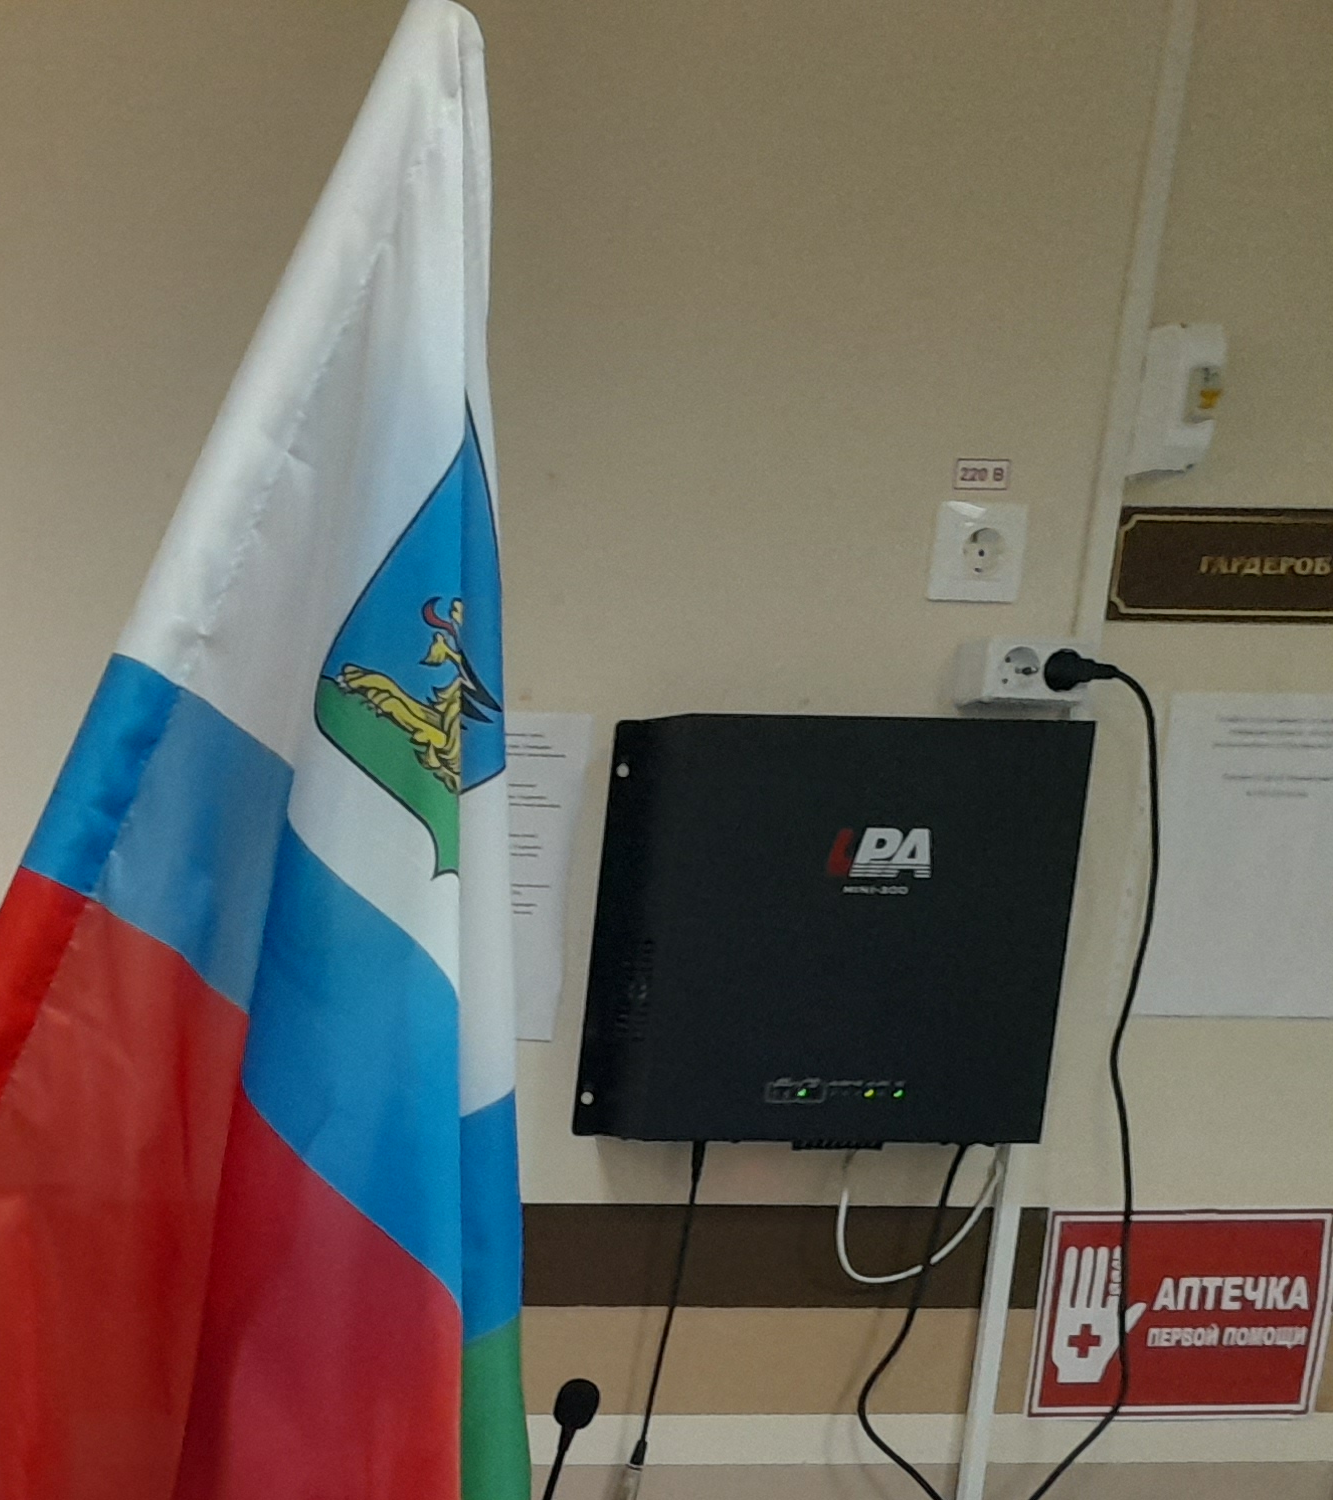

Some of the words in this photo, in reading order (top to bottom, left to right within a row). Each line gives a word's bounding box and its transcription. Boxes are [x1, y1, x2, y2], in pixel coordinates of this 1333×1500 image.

[960, 467, 987, 481] 220
[1198, 555, 1331, 577] ГАРДЕРОБ
[1152, 1276, 1309, 1311] АПТЕЧКА
[1147, 1323, 1219, 1347] ПЕРВОЙ
[1222, 1326, 1307, 1348] ПОМОЩИ
